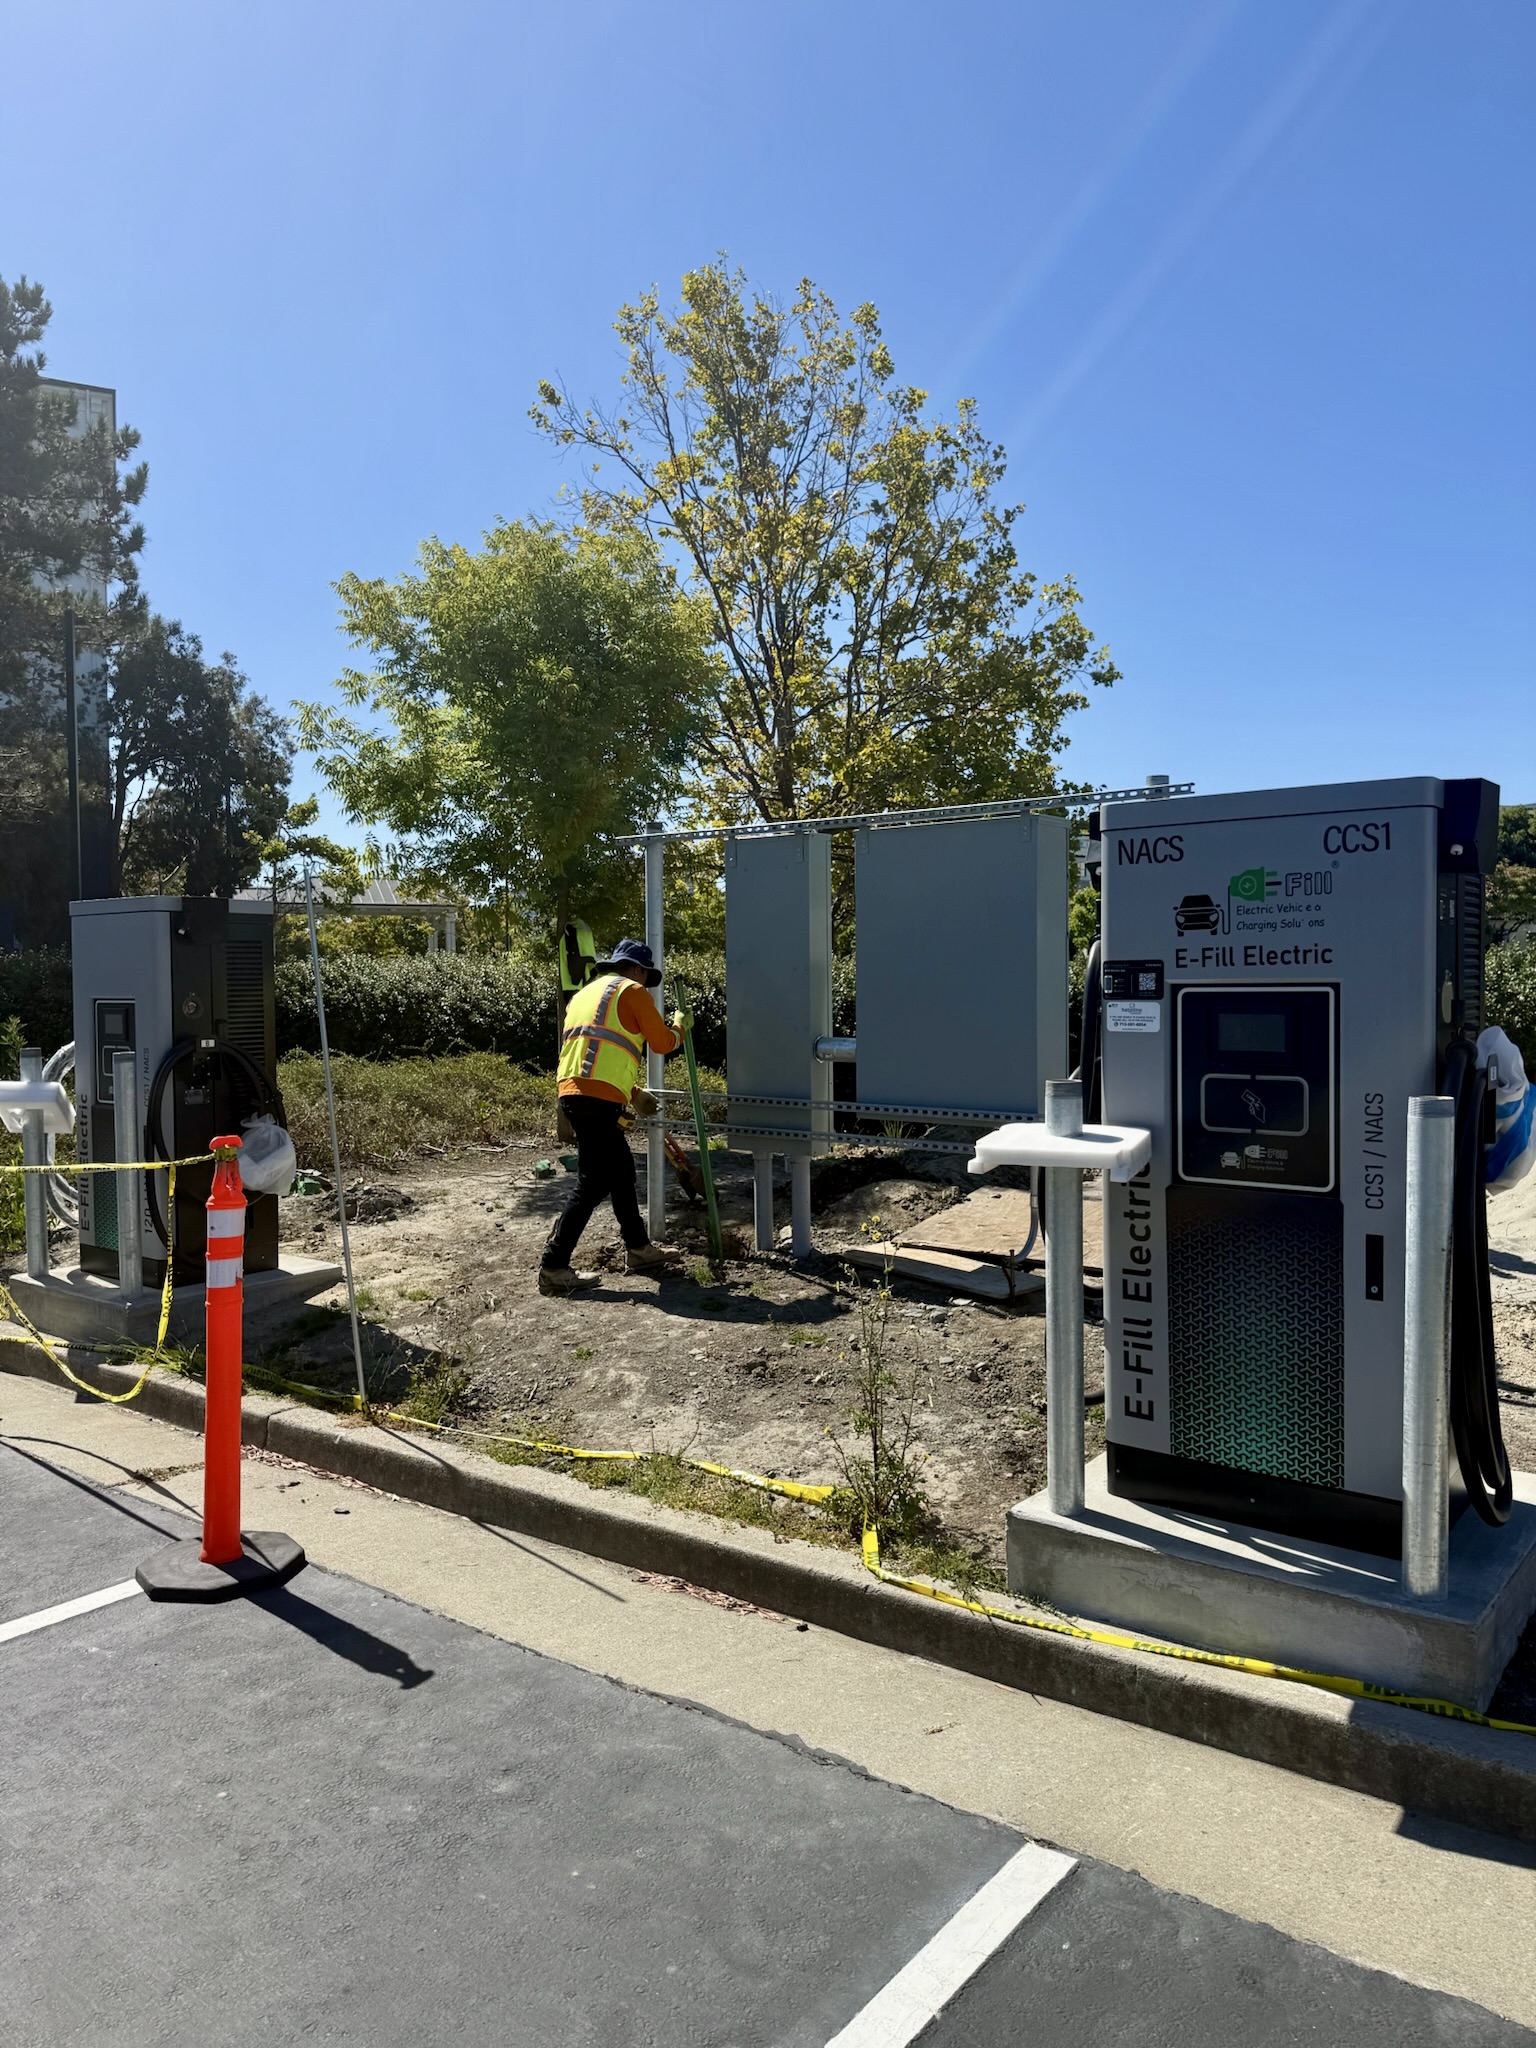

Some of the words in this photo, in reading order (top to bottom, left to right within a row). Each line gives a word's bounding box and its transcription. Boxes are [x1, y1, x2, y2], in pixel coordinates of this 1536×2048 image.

[1118, 835, 1184, 865] NACS
[1324, 822, 1392, 854] CCS1
[1236, 905, 1274, 916] Electric
[1276, 903, 1311, 913] Vehice
[1236, 920, 1277, 933] Charging
[1175, 946, 1235, 969] E-Fill
[1243, 943, 1333, 966] Electric
[78, 1093, 90, 1165] Electric
[1364, 1092, 1384, 1143] NACS
[1362, 1149, 1387, 1159] /
[1364, 1164, 1384, 1210] CCS1
[79, 1177, 91, 1232] E-Fill
[1123, 1316, 1156, 1422] E-Fill
